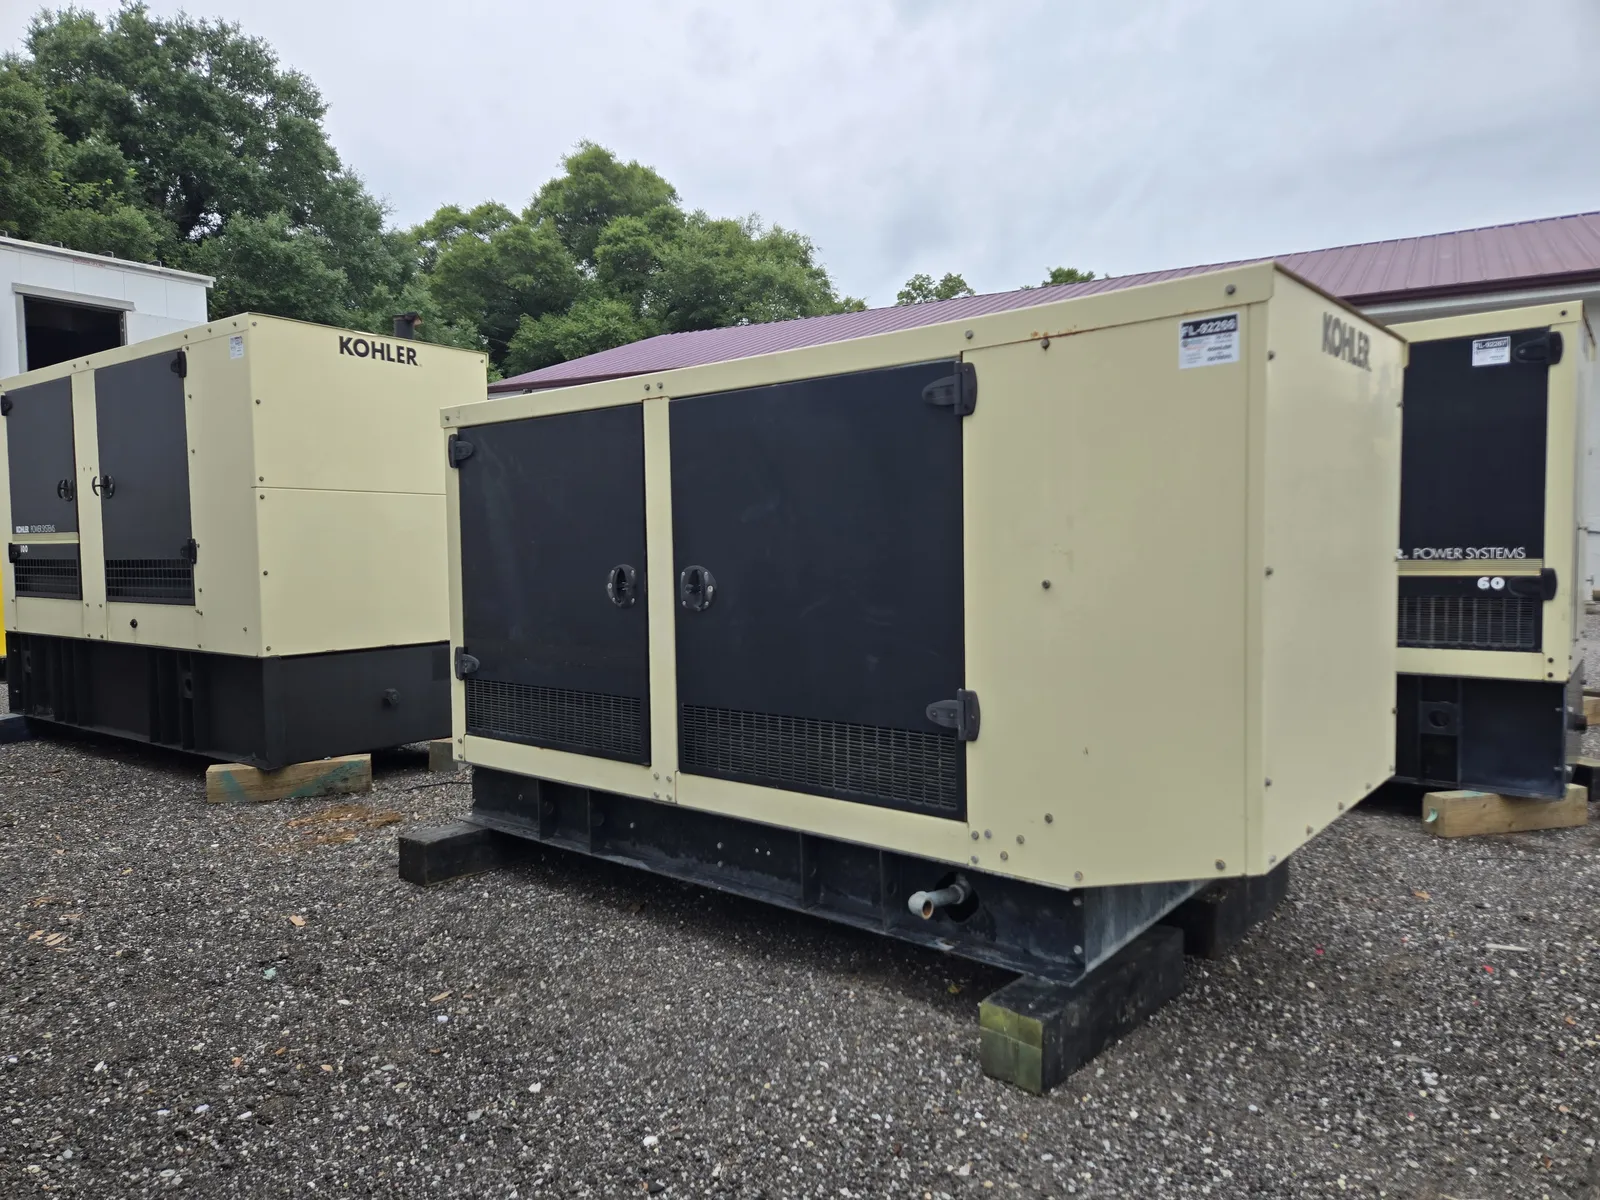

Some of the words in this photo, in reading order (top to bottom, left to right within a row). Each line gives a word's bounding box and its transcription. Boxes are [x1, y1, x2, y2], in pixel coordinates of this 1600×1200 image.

[338, 335, 419, 367] KOHLER
[1322, 311, 1373, 373] KOHLER
[1413, 547, 1463, 559] POWER
[1464, 545, 1526, 559] SYSTEMS
[1477, 576, 1506, 589] 60
